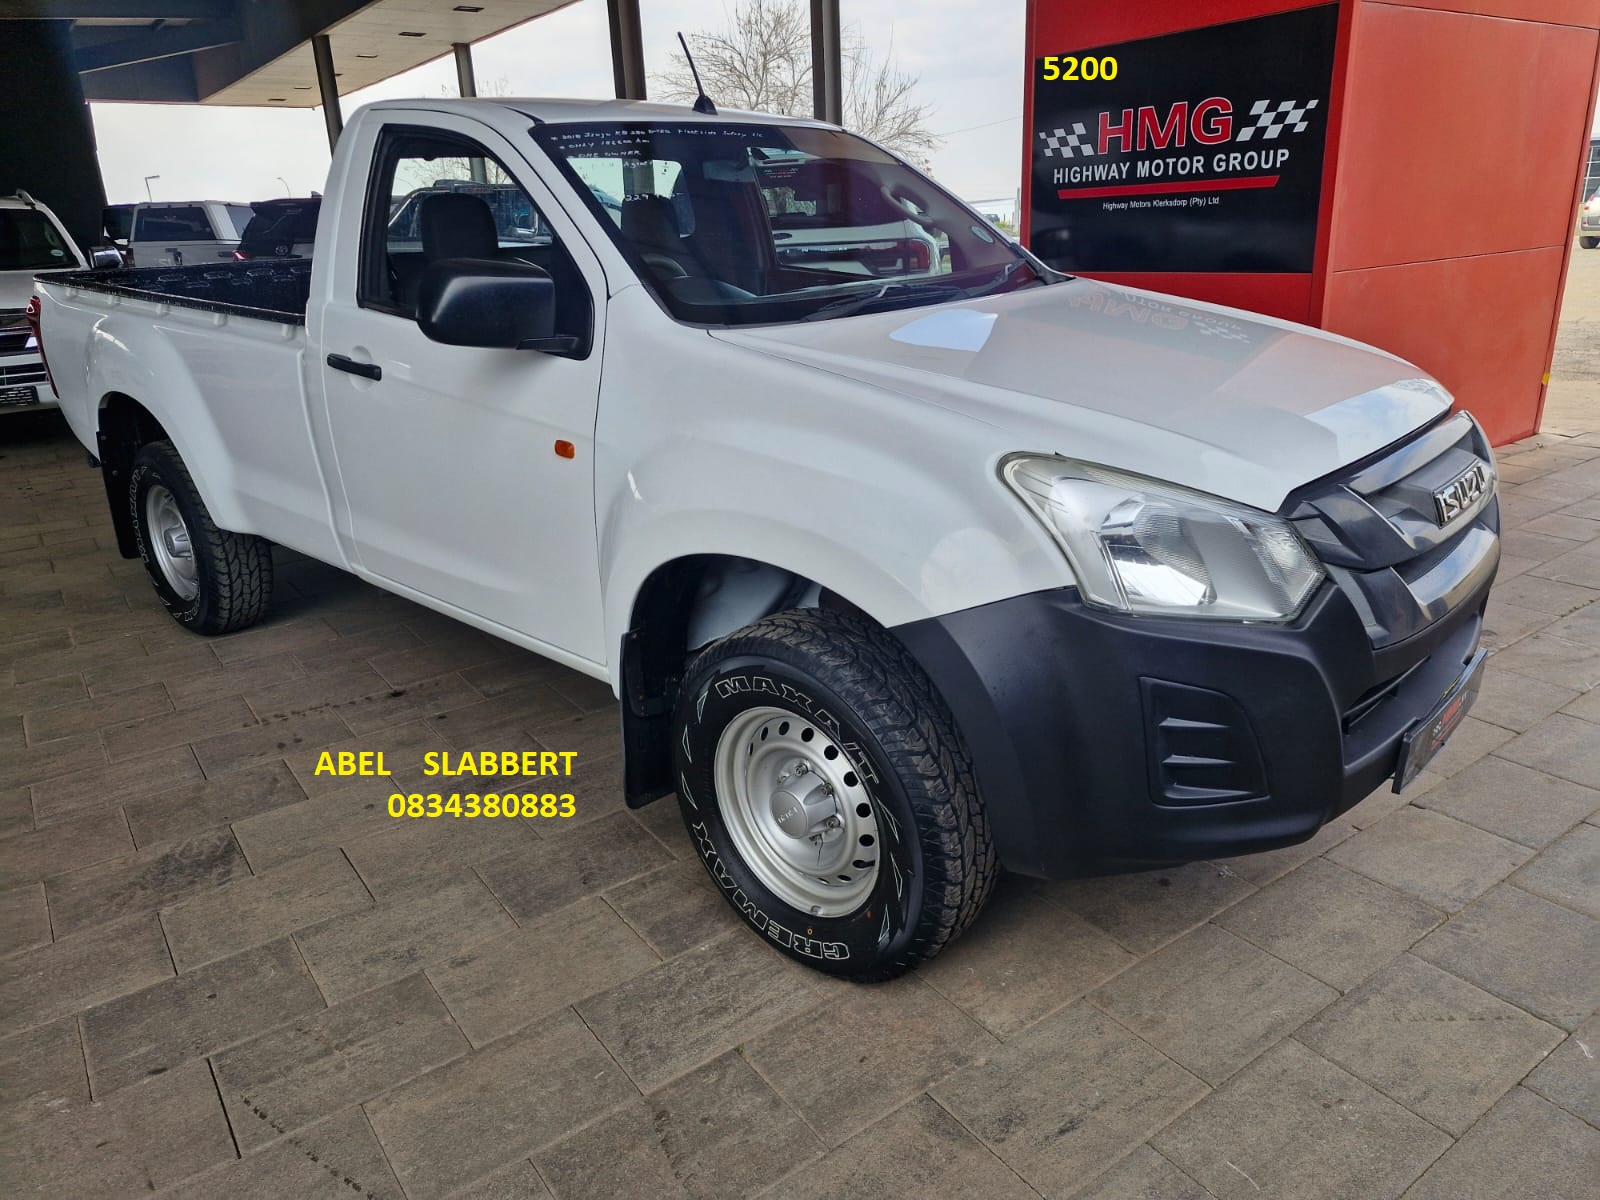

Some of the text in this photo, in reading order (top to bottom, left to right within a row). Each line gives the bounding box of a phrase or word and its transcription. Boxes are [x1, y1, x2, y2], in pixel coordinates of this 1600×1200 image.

[1097, 96, 1233, 155] HMG
[1053, 149, 1290, 185] HIGHWAY MOTOR GROUP
[1102, 196, 1220, 211] Highway Motors Klerksdorp (Pty) Ltd
[1435, 462, 1487, 521] ISUZU
[692, 821, 850, 960] GREMAX
